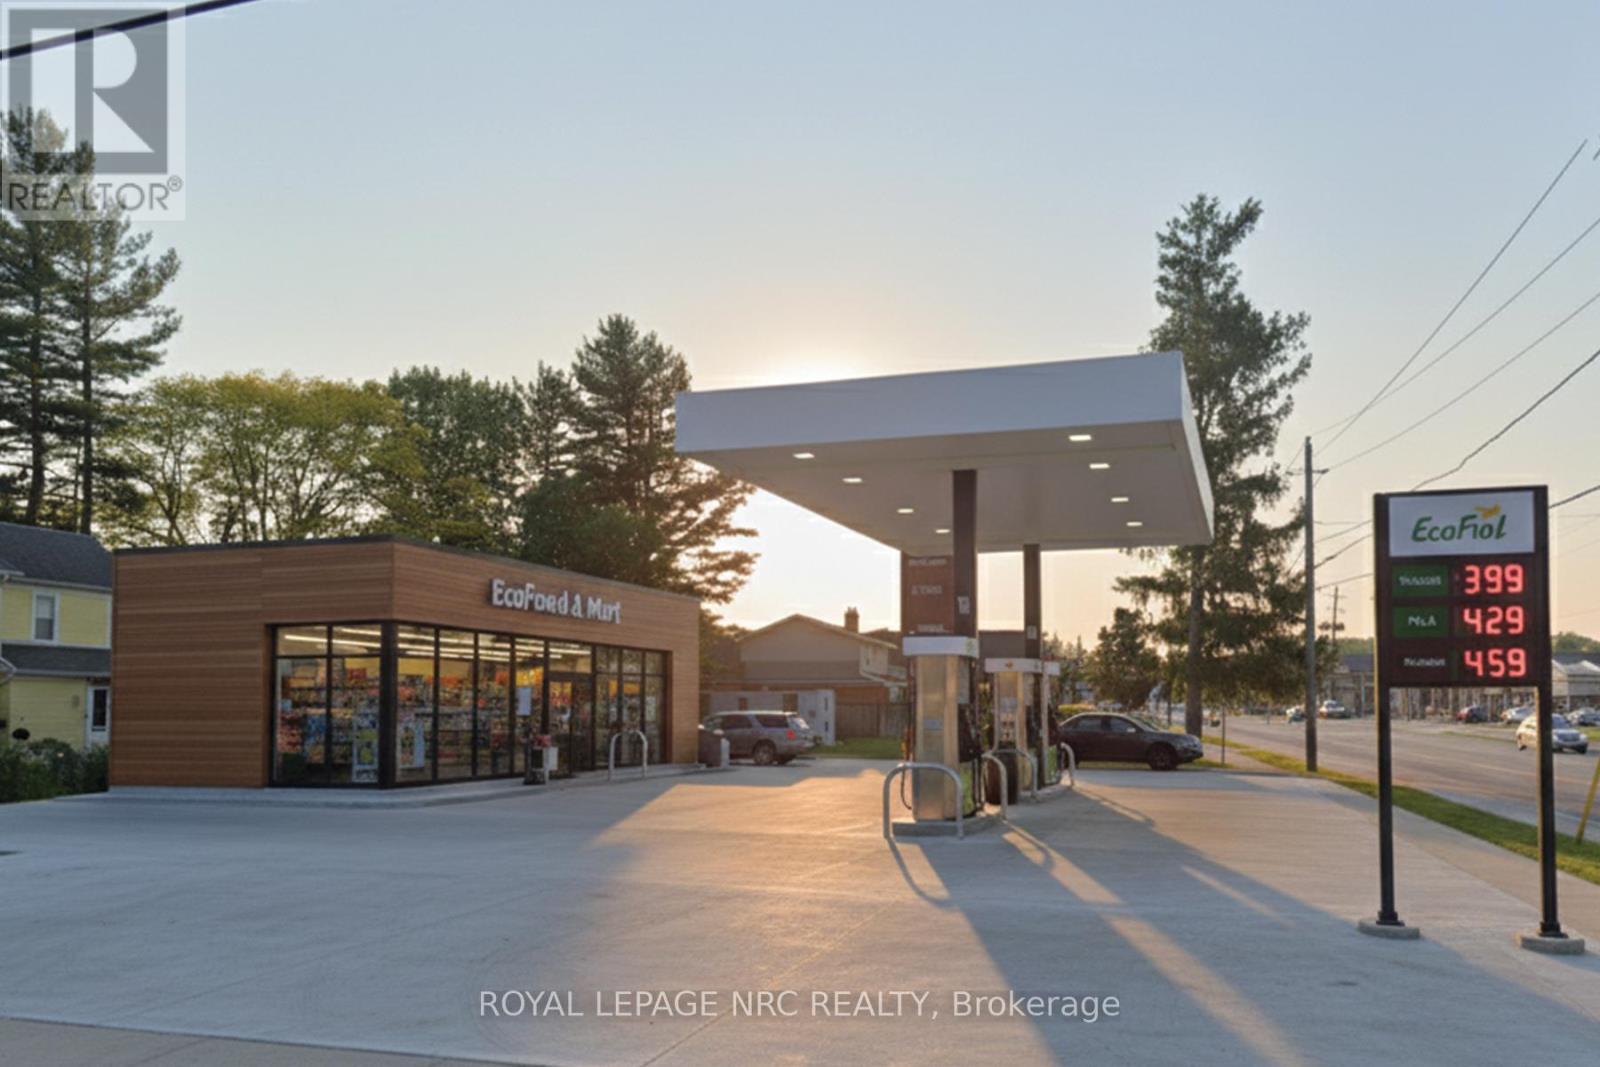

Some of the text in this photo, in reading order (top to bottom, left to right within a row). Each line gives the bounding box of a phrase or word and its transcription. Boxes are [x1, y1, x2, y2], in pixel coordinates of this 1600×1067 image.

[1464, 564, 1524, 594] 399
[1463, 606, 1524, 634] 429
[1464, 648, 1526, 677] 459
